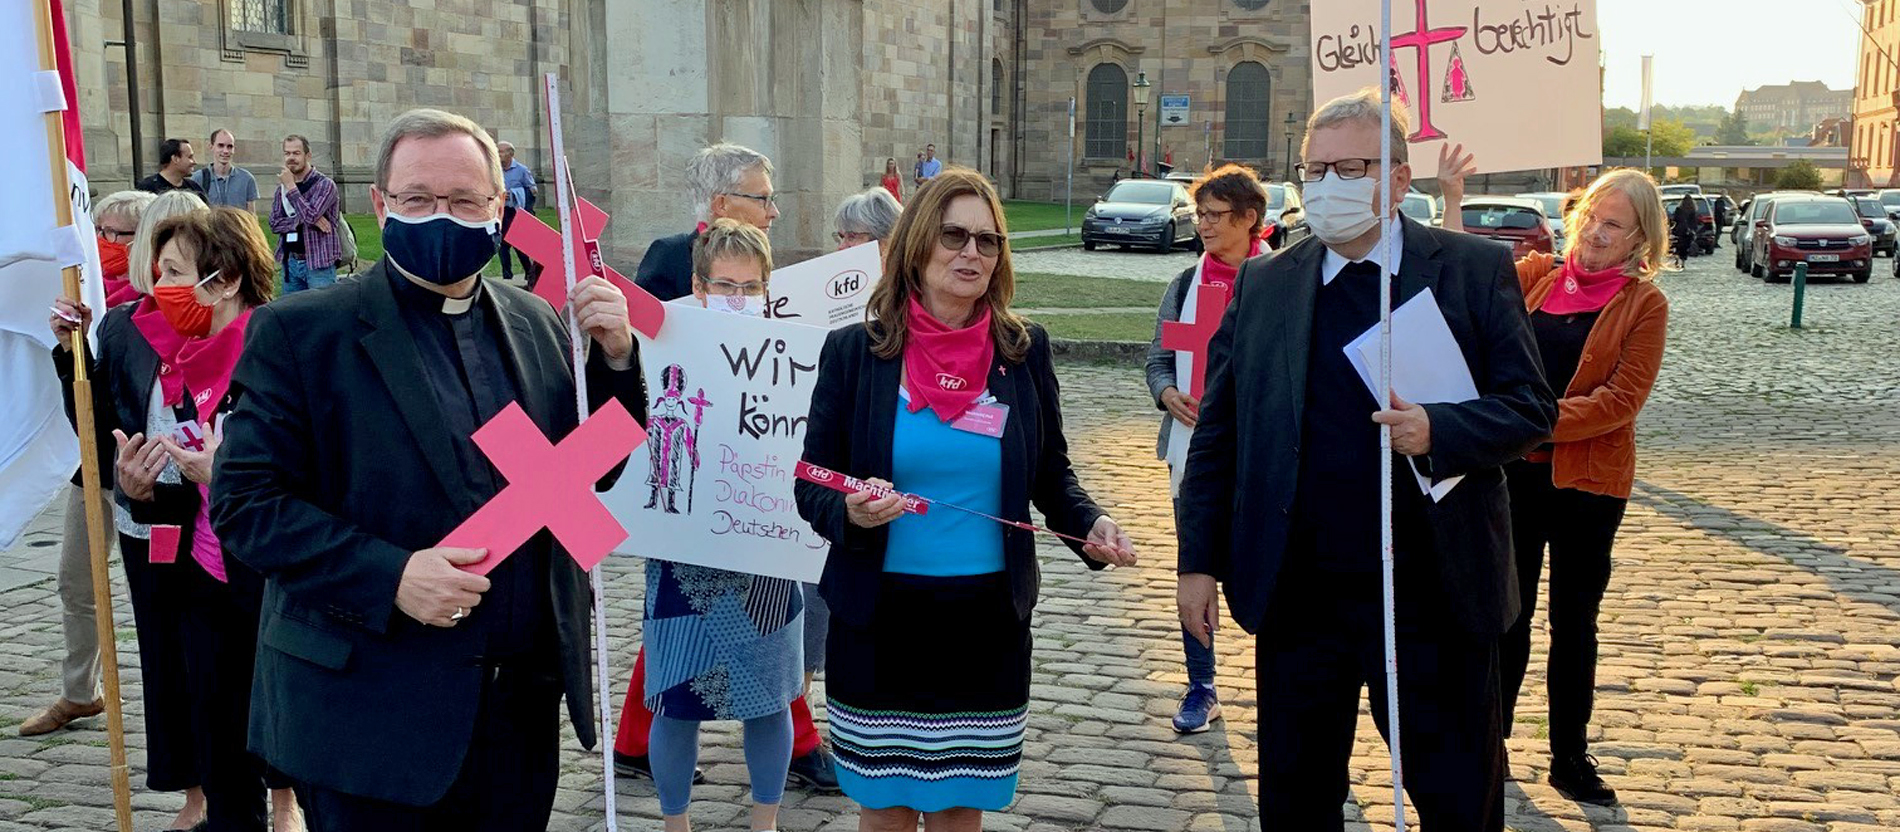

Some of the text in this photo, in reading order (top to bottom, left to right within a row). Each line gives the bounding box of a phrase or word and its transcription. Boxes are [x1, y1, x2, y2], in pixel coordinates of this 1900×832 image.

[1317, 24, 1382, 72] Gleich
[763, 289, 802, 319] te
[834, 274, 860, 297] kfd
[719, 338, 817, 387] Wir
[939, 376, 962, 390] kfd
[738, 391, 809, 441] könn
